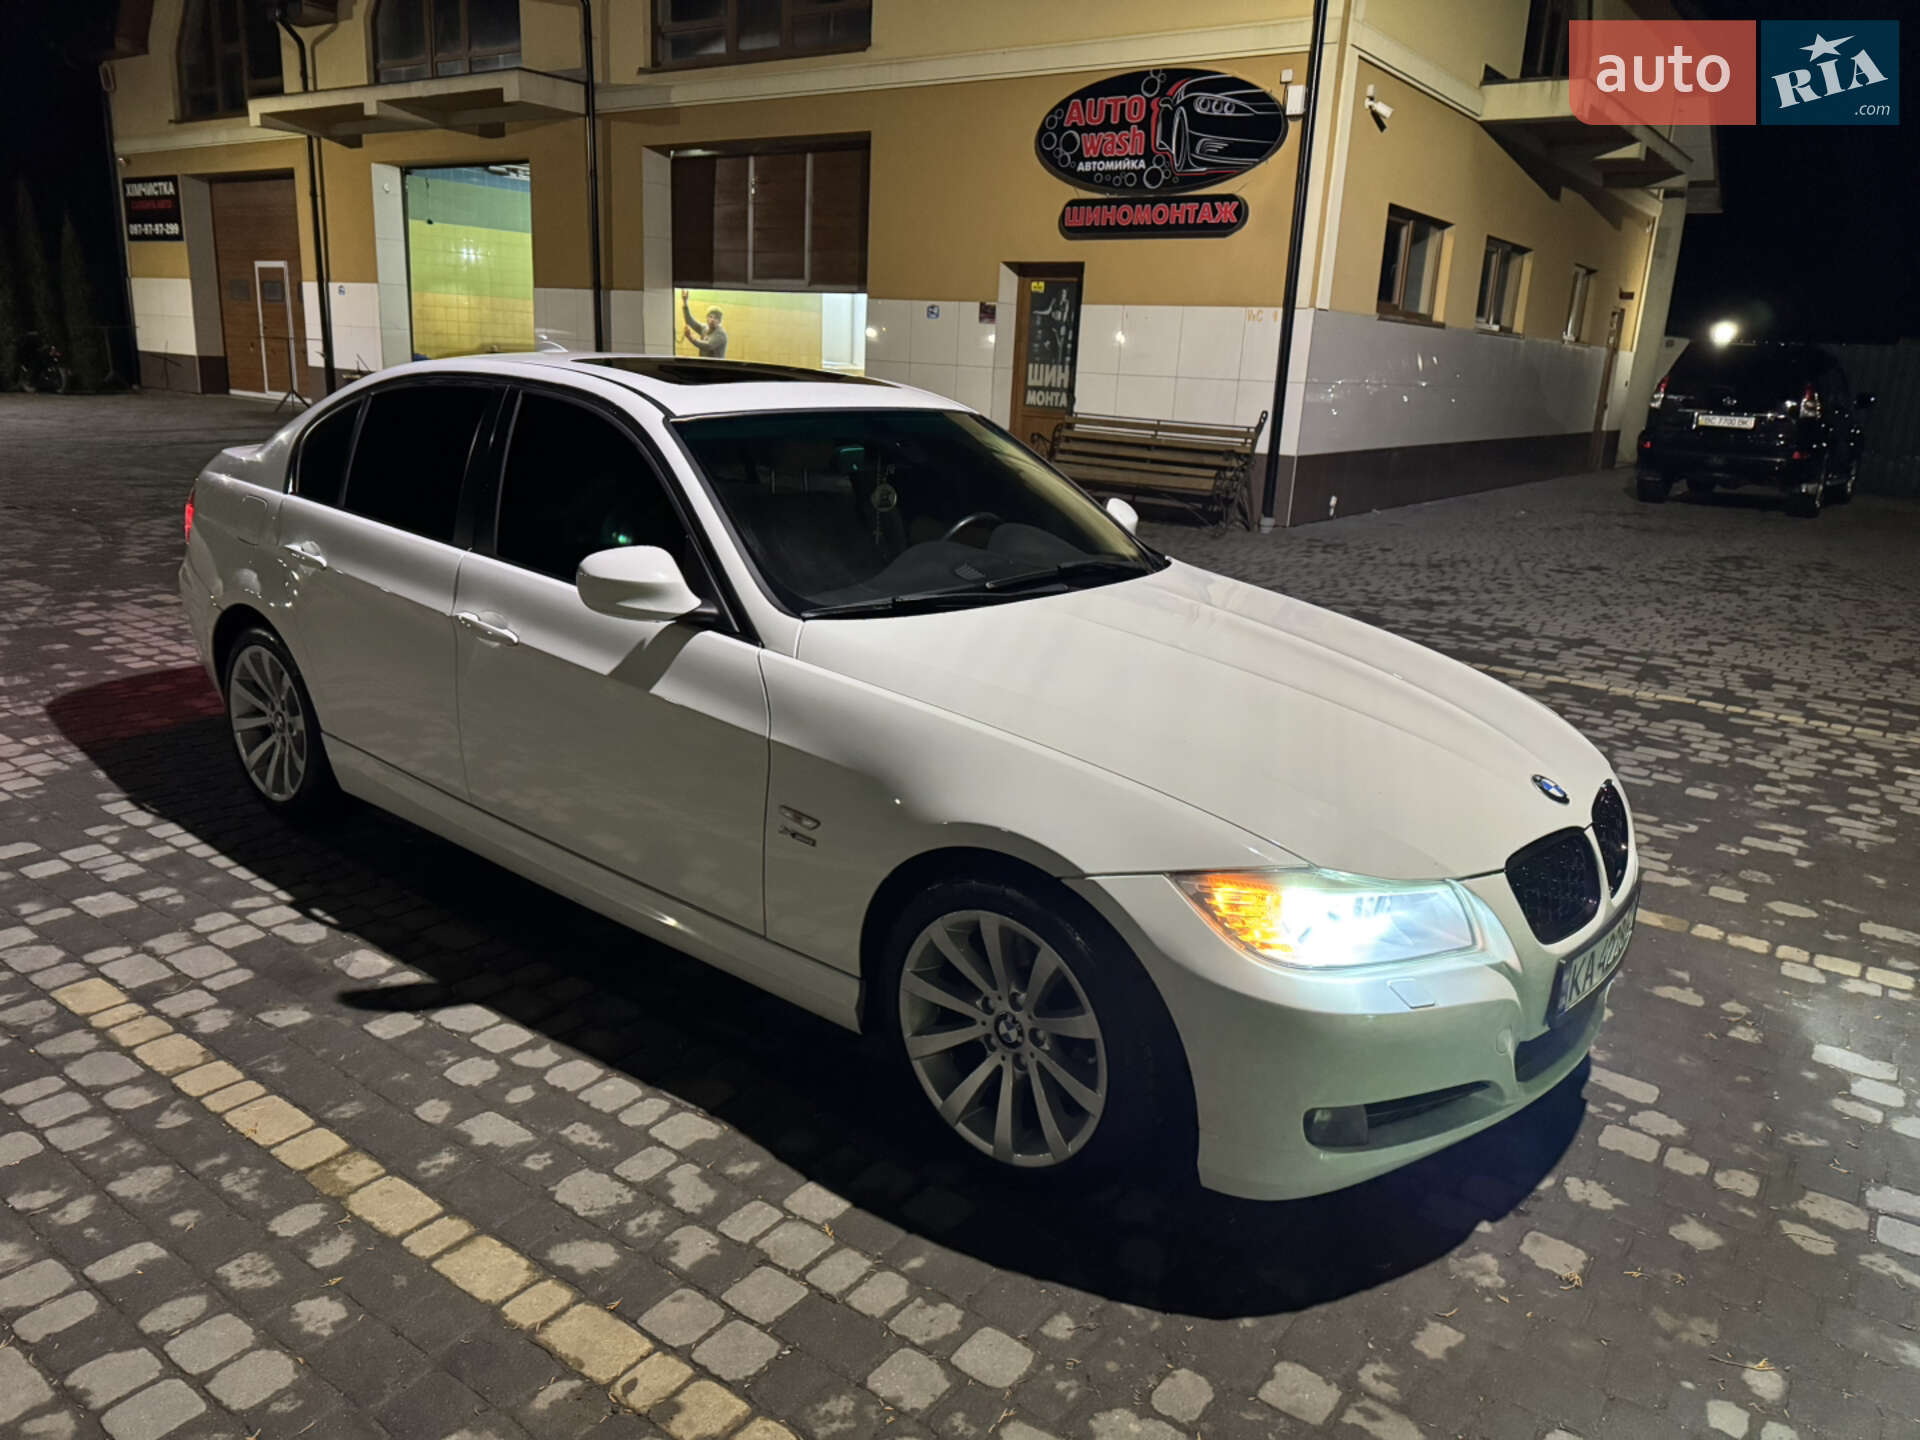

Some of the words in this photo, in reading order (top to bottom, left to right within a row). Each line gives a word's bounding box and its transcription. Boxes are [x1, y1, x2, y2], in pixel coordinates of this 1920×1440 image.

[1063, 95, 1146, 128] AUTO
[1081, 125, 1145, 158] wash
[1077, 158, 1146, 172] АВТОМИЙКА
[1064, 201, 1239, 227] ШИНОМОНТАЖ
[1568, 951, 1595, 1001] KA
